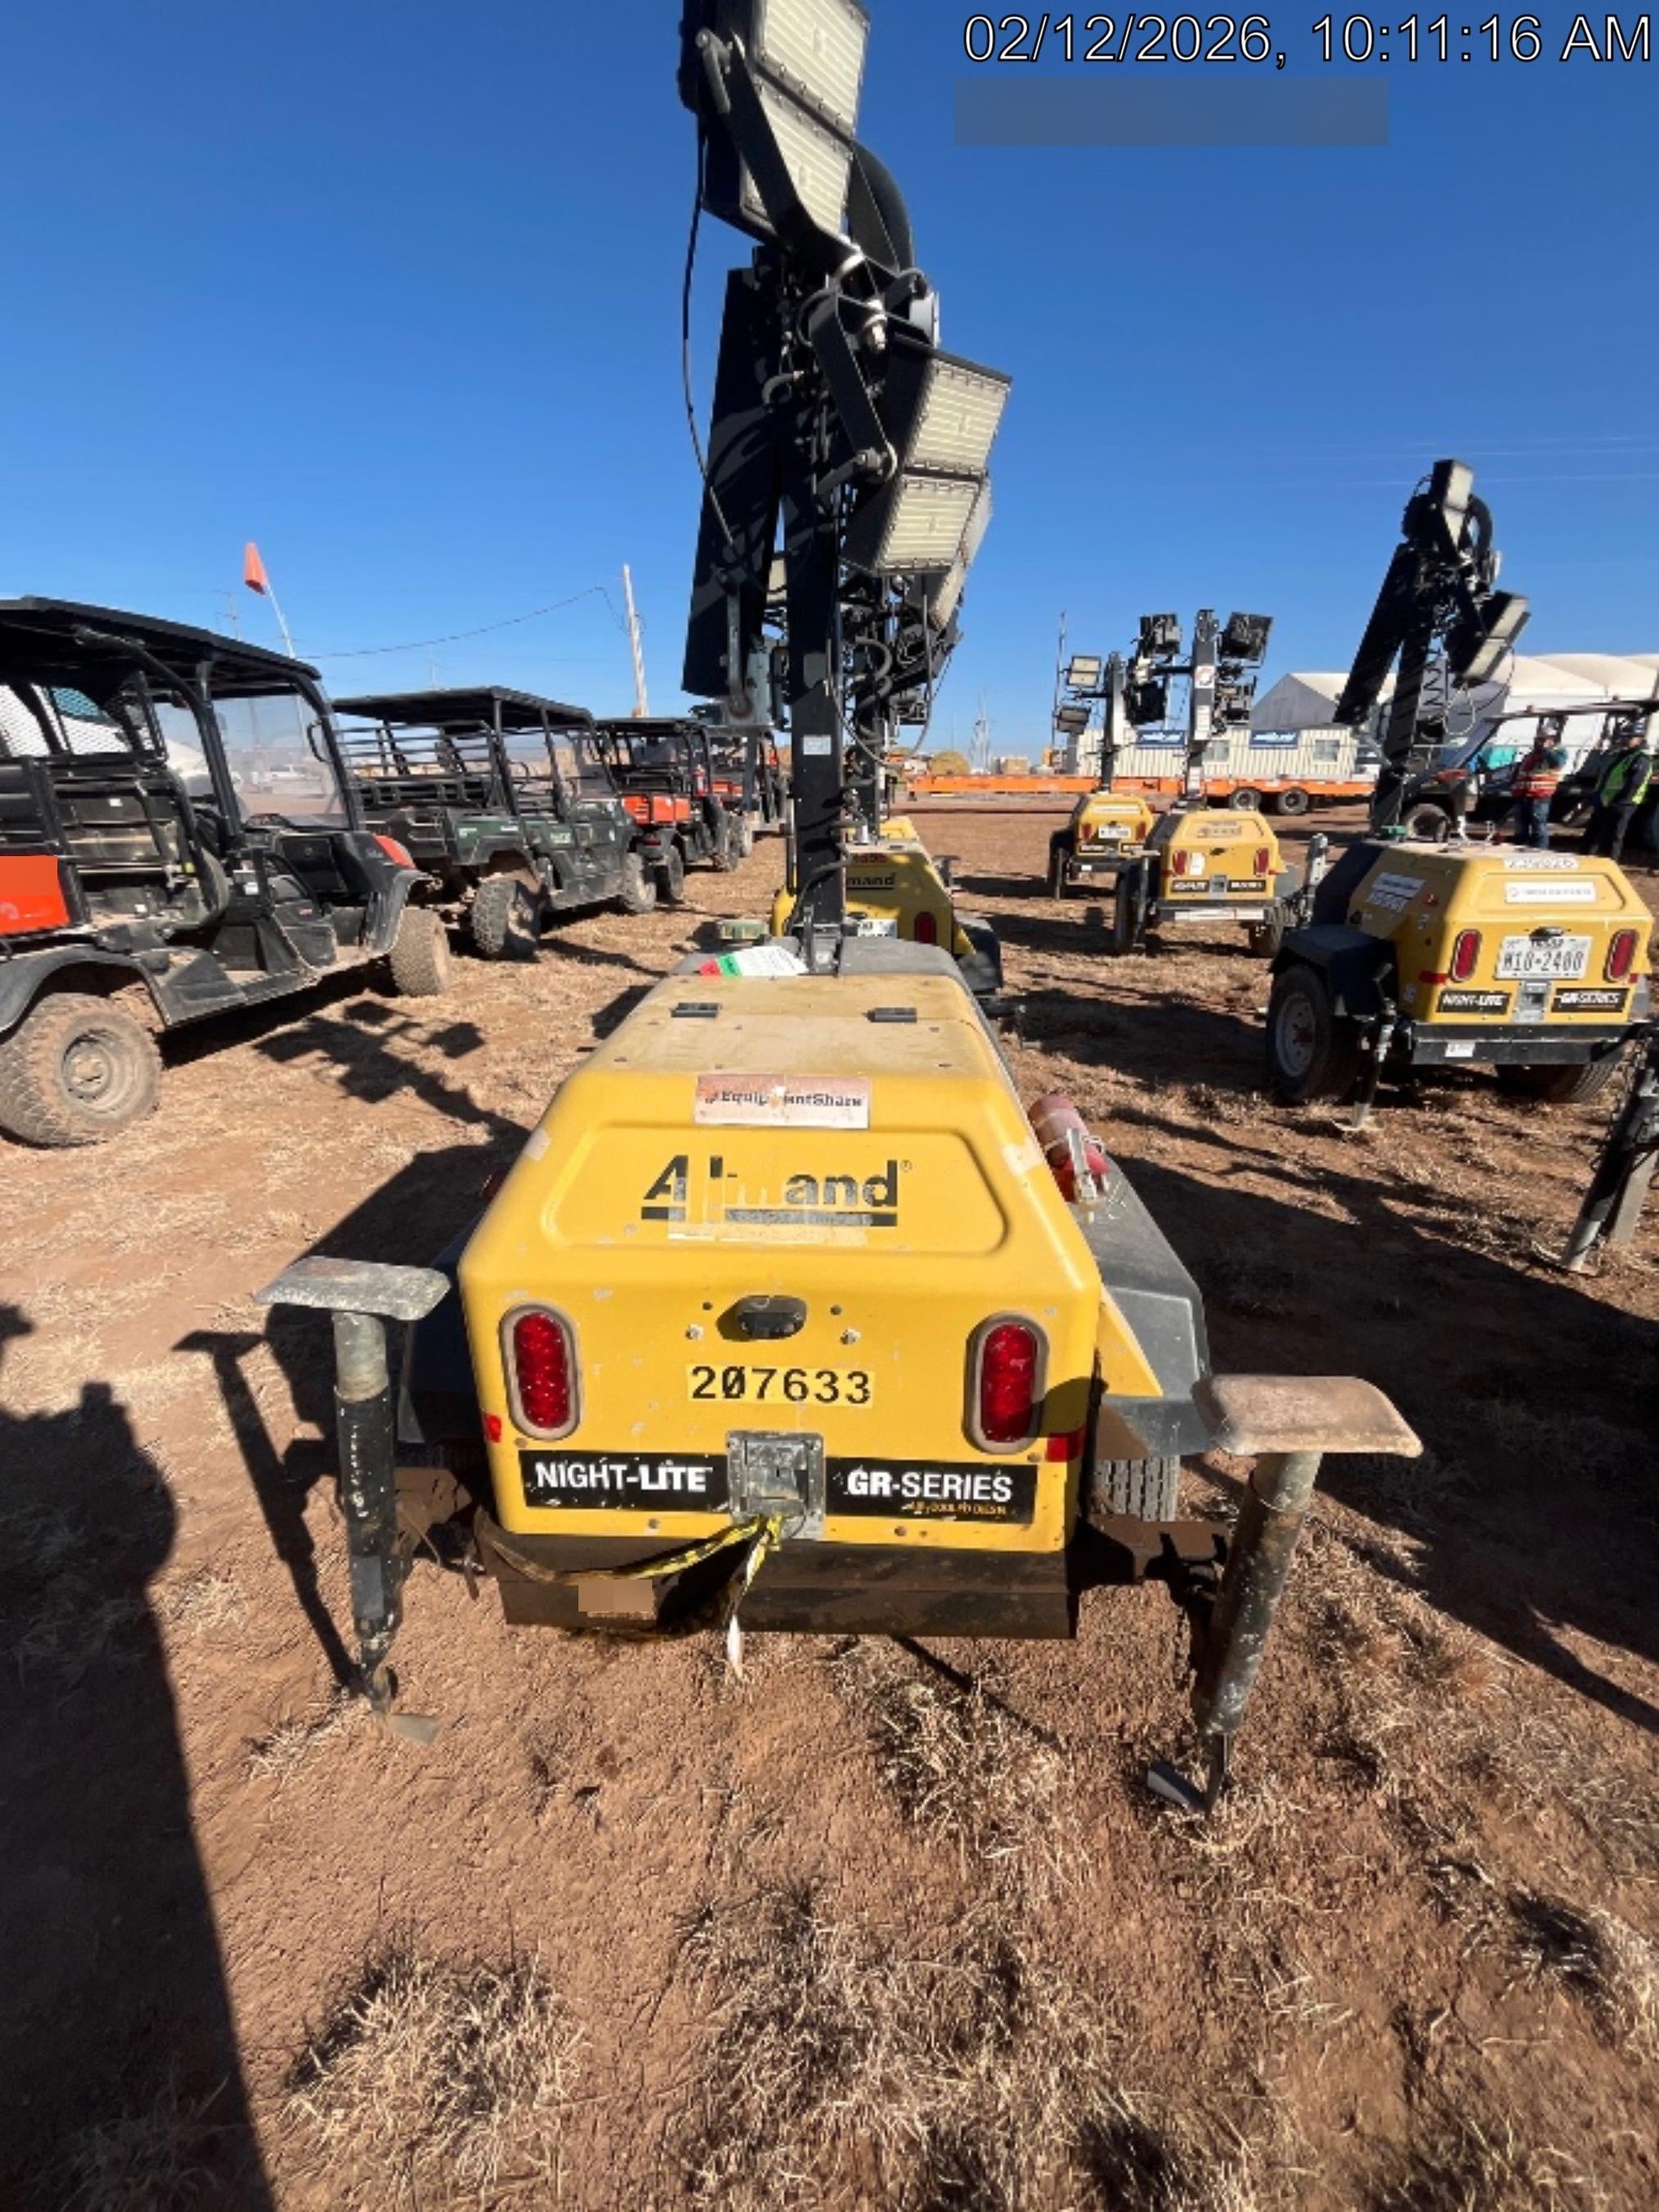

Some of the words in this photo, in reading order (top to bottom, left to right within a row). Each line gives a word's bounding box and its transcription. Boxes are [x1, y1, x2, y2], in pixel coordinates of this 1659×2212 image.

[722, 1090, 863, 1108] EquipentShare
[691, 1366, 871, 1404] 207633
[534, 1461, 710, 1493] NIGHT-LITE
[847, 1469, 1013, 1503] GR-SERIES
